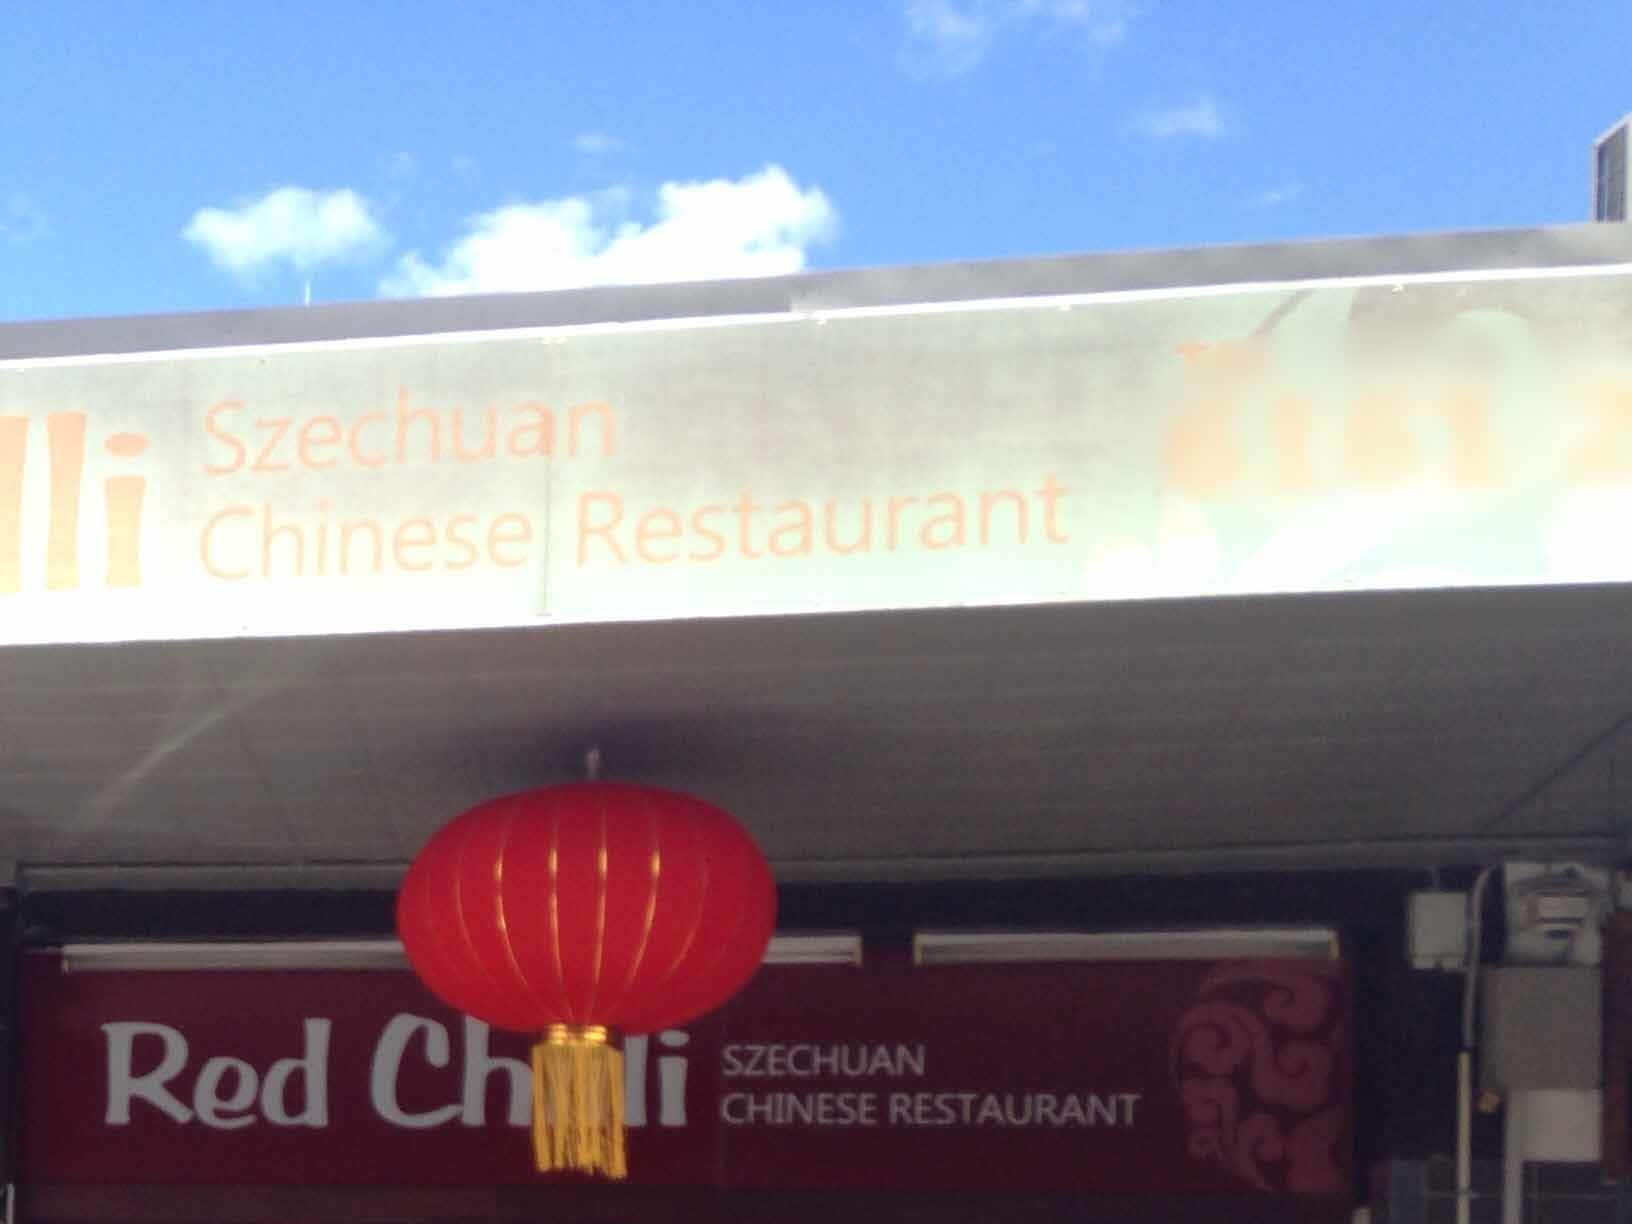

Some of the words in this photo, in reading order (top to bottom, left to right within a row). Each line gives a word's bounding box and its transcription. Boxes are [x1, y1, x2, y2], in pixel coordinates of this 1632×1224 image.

[202, 386, 619, 476] Szechuan
[198, 497, 535, 583] Chinese
[576, 472, 1072, 569] Restaurant
[100, 1018, 332, 1130] Red
[370, 1012, 690, 1130] Chli
[720, 1043, 927, 1078] SZECHUAN
[720, 1091, 880, 1127] CHINESE
[888, 1091, 1142, 1127] RESTAURANT
